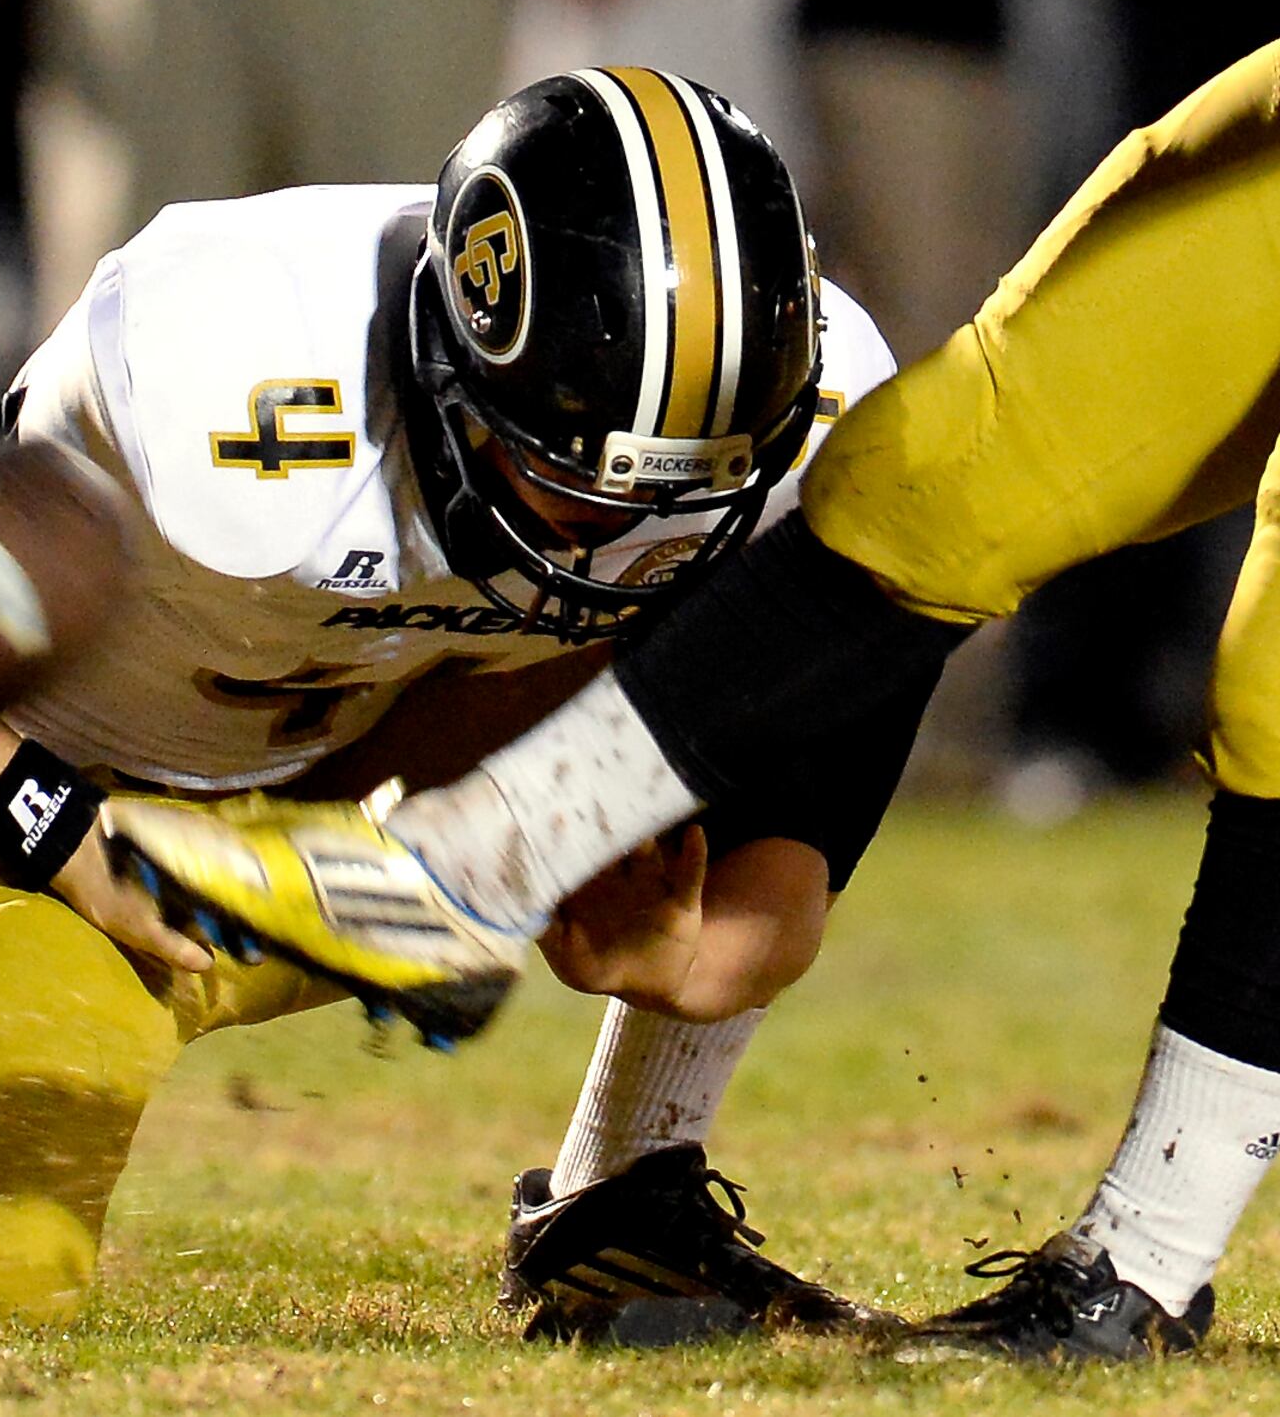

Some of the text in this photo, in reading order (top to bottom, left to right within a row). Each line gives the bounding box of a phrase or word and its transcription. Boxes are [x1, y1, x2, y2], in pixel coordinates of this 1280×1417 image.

[208, 378, 356, 479] 4
[316, 578, 388, 589] RUSSELL
[332, 549, 385, 579] R
[318, 603, 570, 637] PACKE
[7, 777, 53, 836] R
[21, 784, 72, 855] RUSSELL
